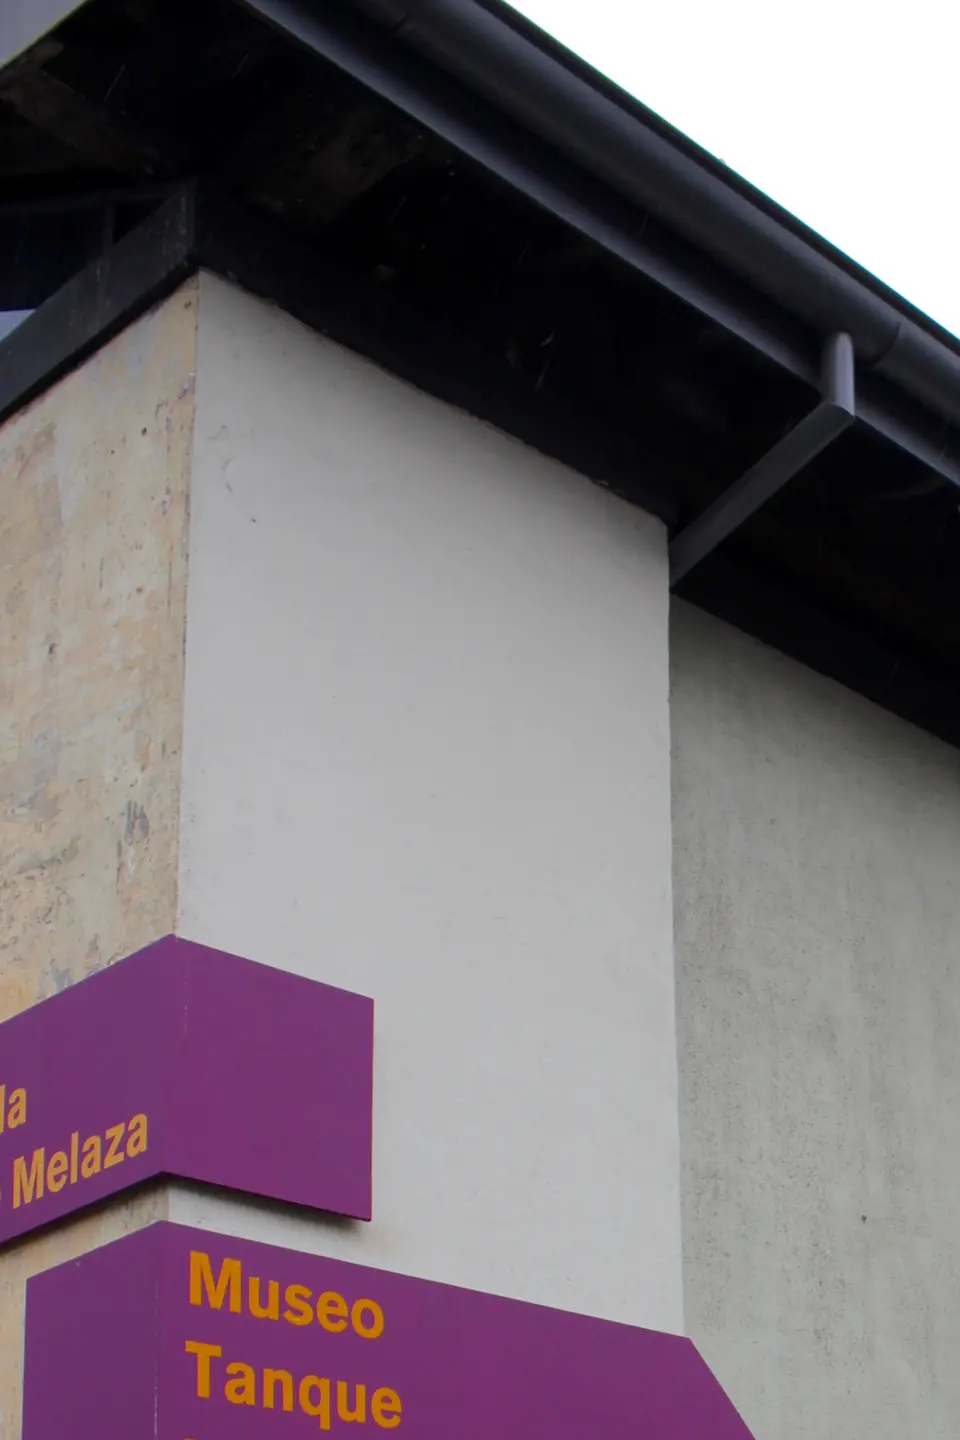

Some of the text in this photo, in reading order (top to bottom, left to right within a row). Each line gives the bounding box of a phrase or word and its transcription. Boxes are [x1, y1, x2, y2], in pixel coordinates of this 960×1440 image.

[12, 1112, 148, 1209] Melaza
[188, 1249, 386, 1340] Museo
[184, 1339, 403, 1432] Tanque
